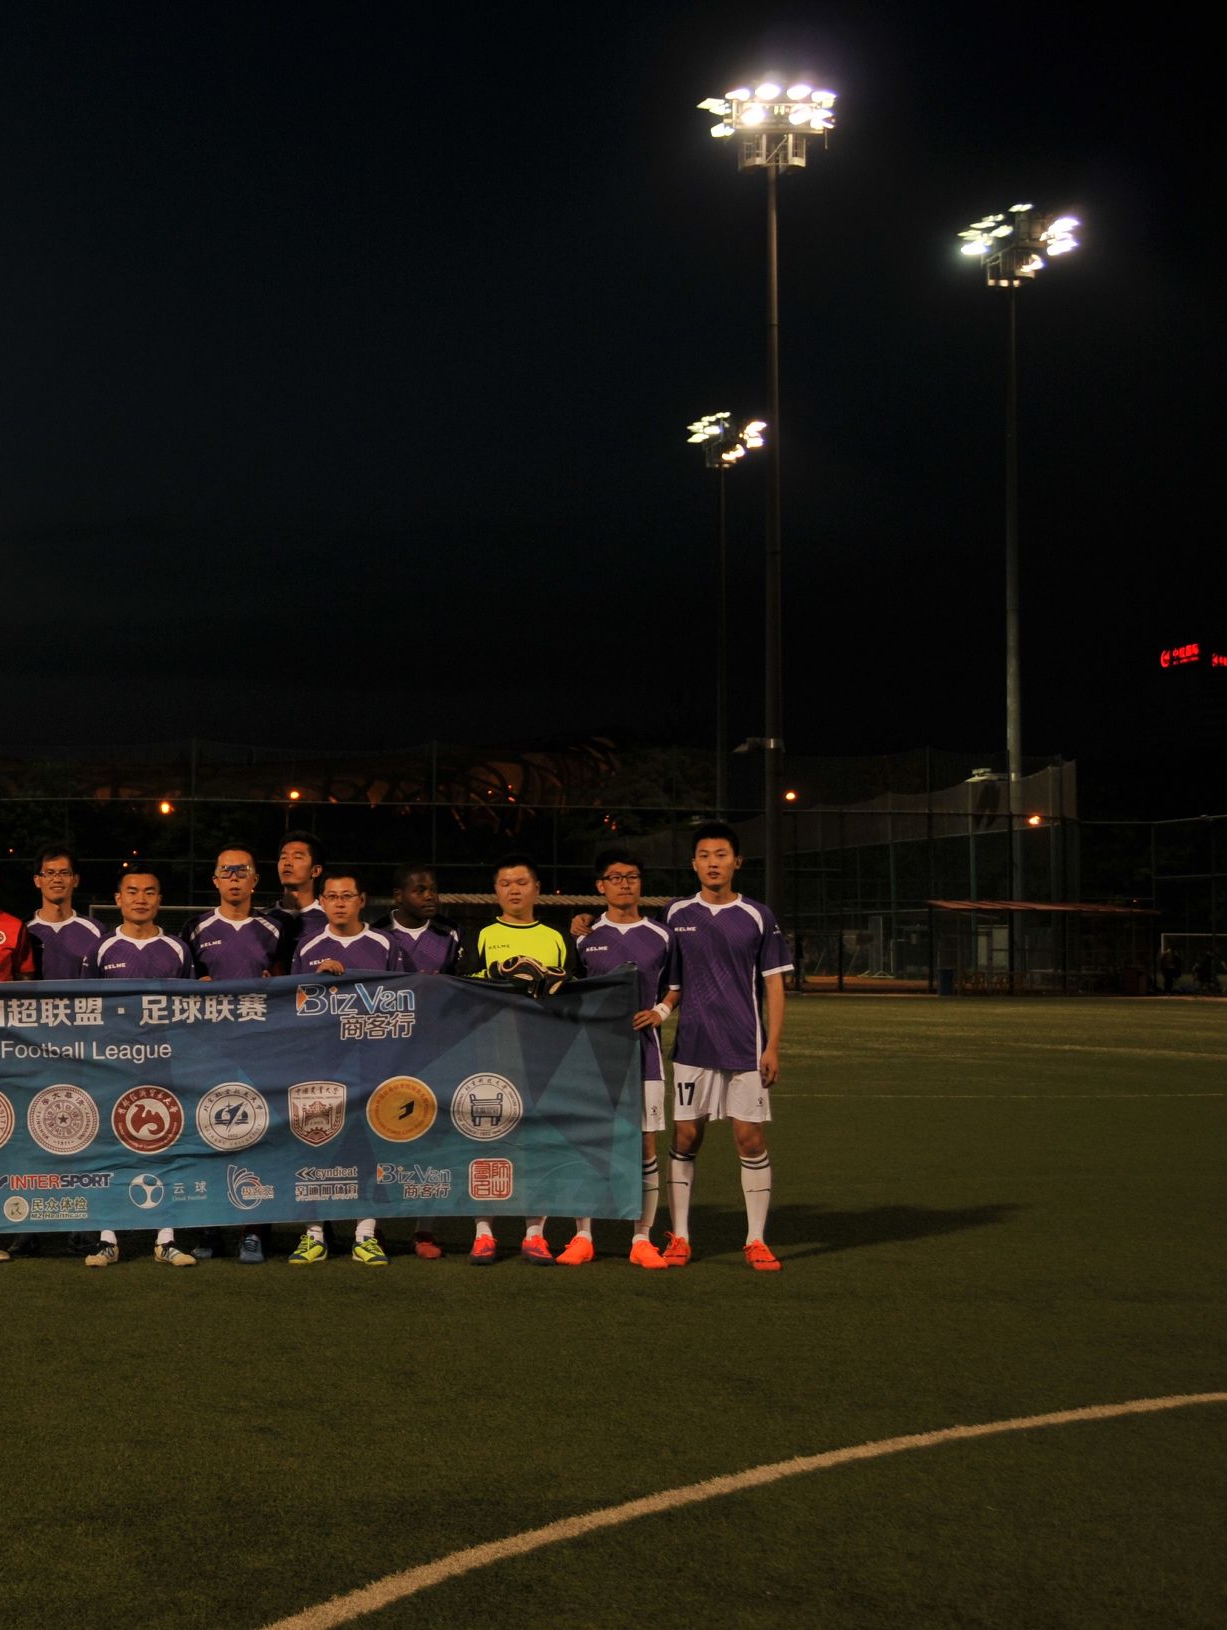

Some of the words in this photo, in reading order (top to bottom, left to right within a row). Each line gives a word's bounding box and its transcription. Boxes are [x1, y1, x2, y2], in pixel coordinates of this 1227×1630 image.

[296, 983, 416, 1016] BizVan
[340, 1012, 416, 1041] 商客行
[0, 1040, 85, 1061] Football
[92, 1041, 173, 1064] League
[677, 1082, 696, 1106] 17
[10, 1173, 112, 1190] INTERSPORT
[376, 1163, 451, 1185] BizVan
[31, 1197, 87, 1211] 民众体检
